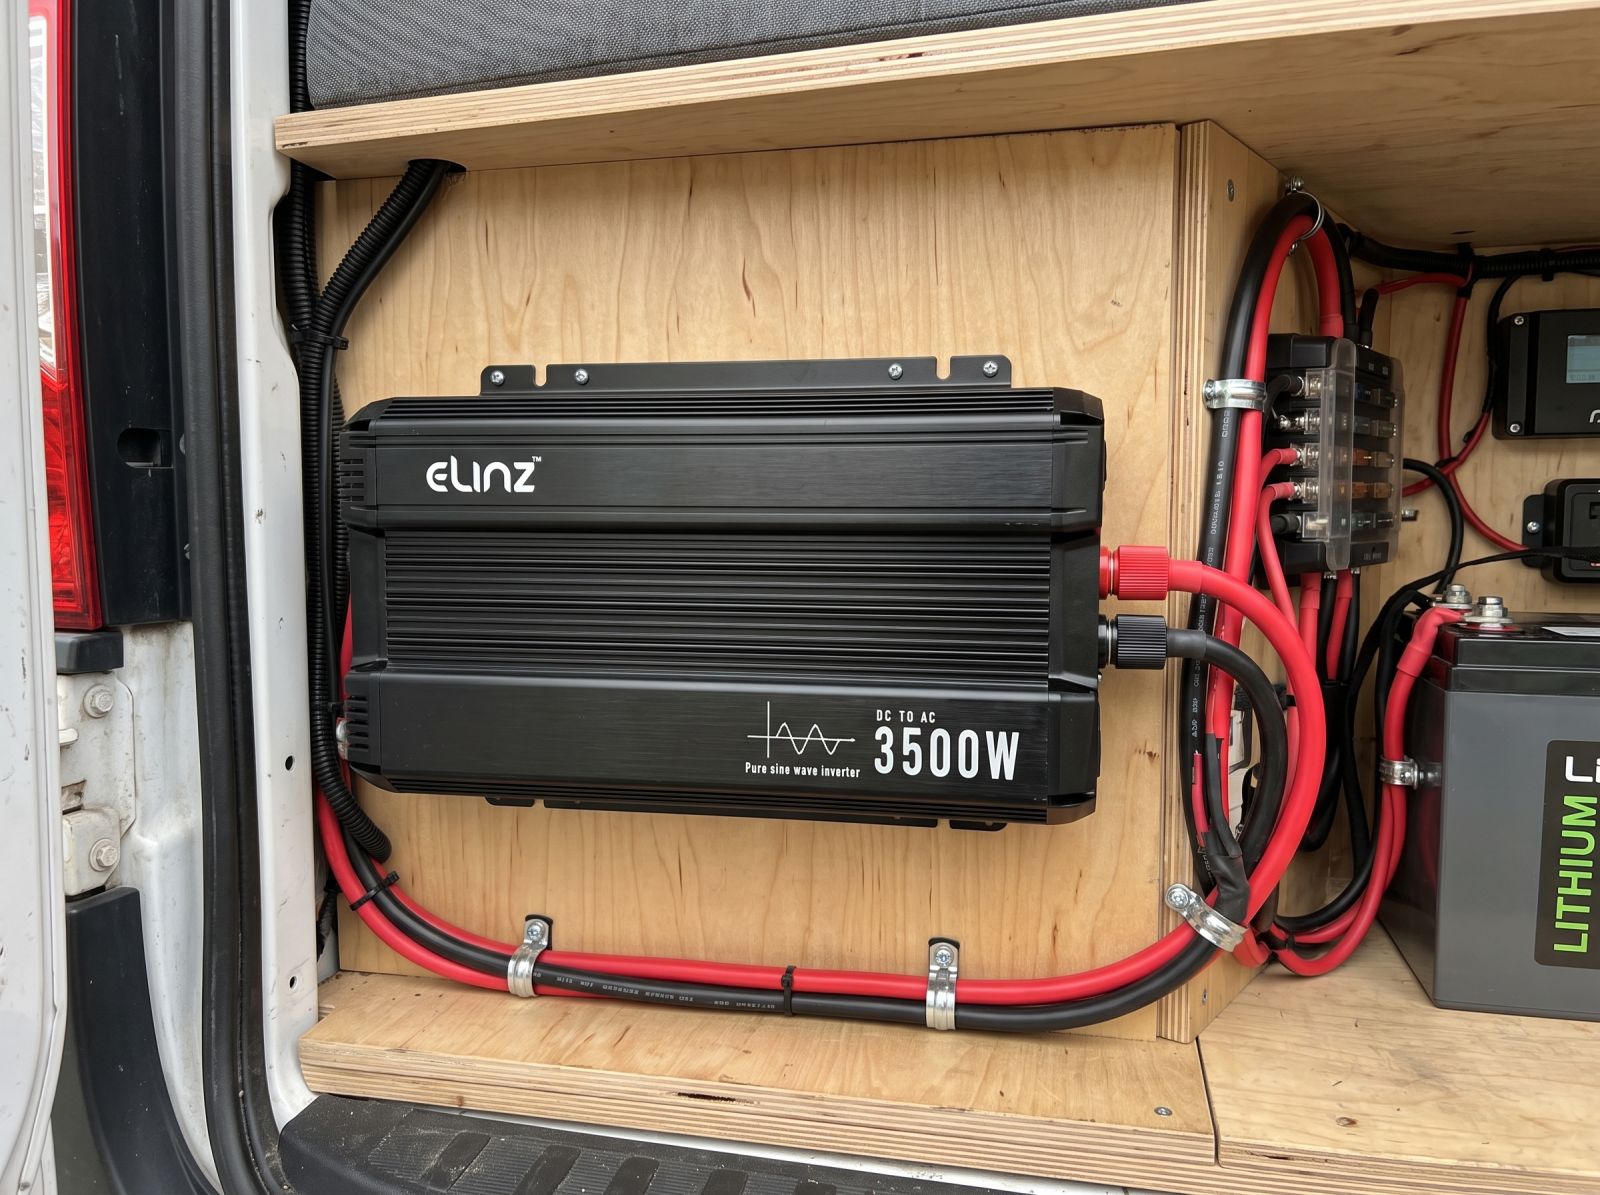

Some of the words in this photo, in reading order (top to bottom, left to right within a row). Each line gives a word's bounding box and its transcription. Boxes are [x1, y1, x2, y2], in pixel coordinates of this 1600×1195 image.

[876, 709, 892, 722] DC
[899, 710, 914, 723] TO
[920, 711, 936, 724] AC
[745, 761, 767, 775] Pure
[770, 763, 791, 776] sine
[793, 766, 818, 777] wave
[821, 765, 861, 779] inverter
[874, 725, 1020, 781] 3500W
[1554, 795, 1598, 953] LITHIUM
